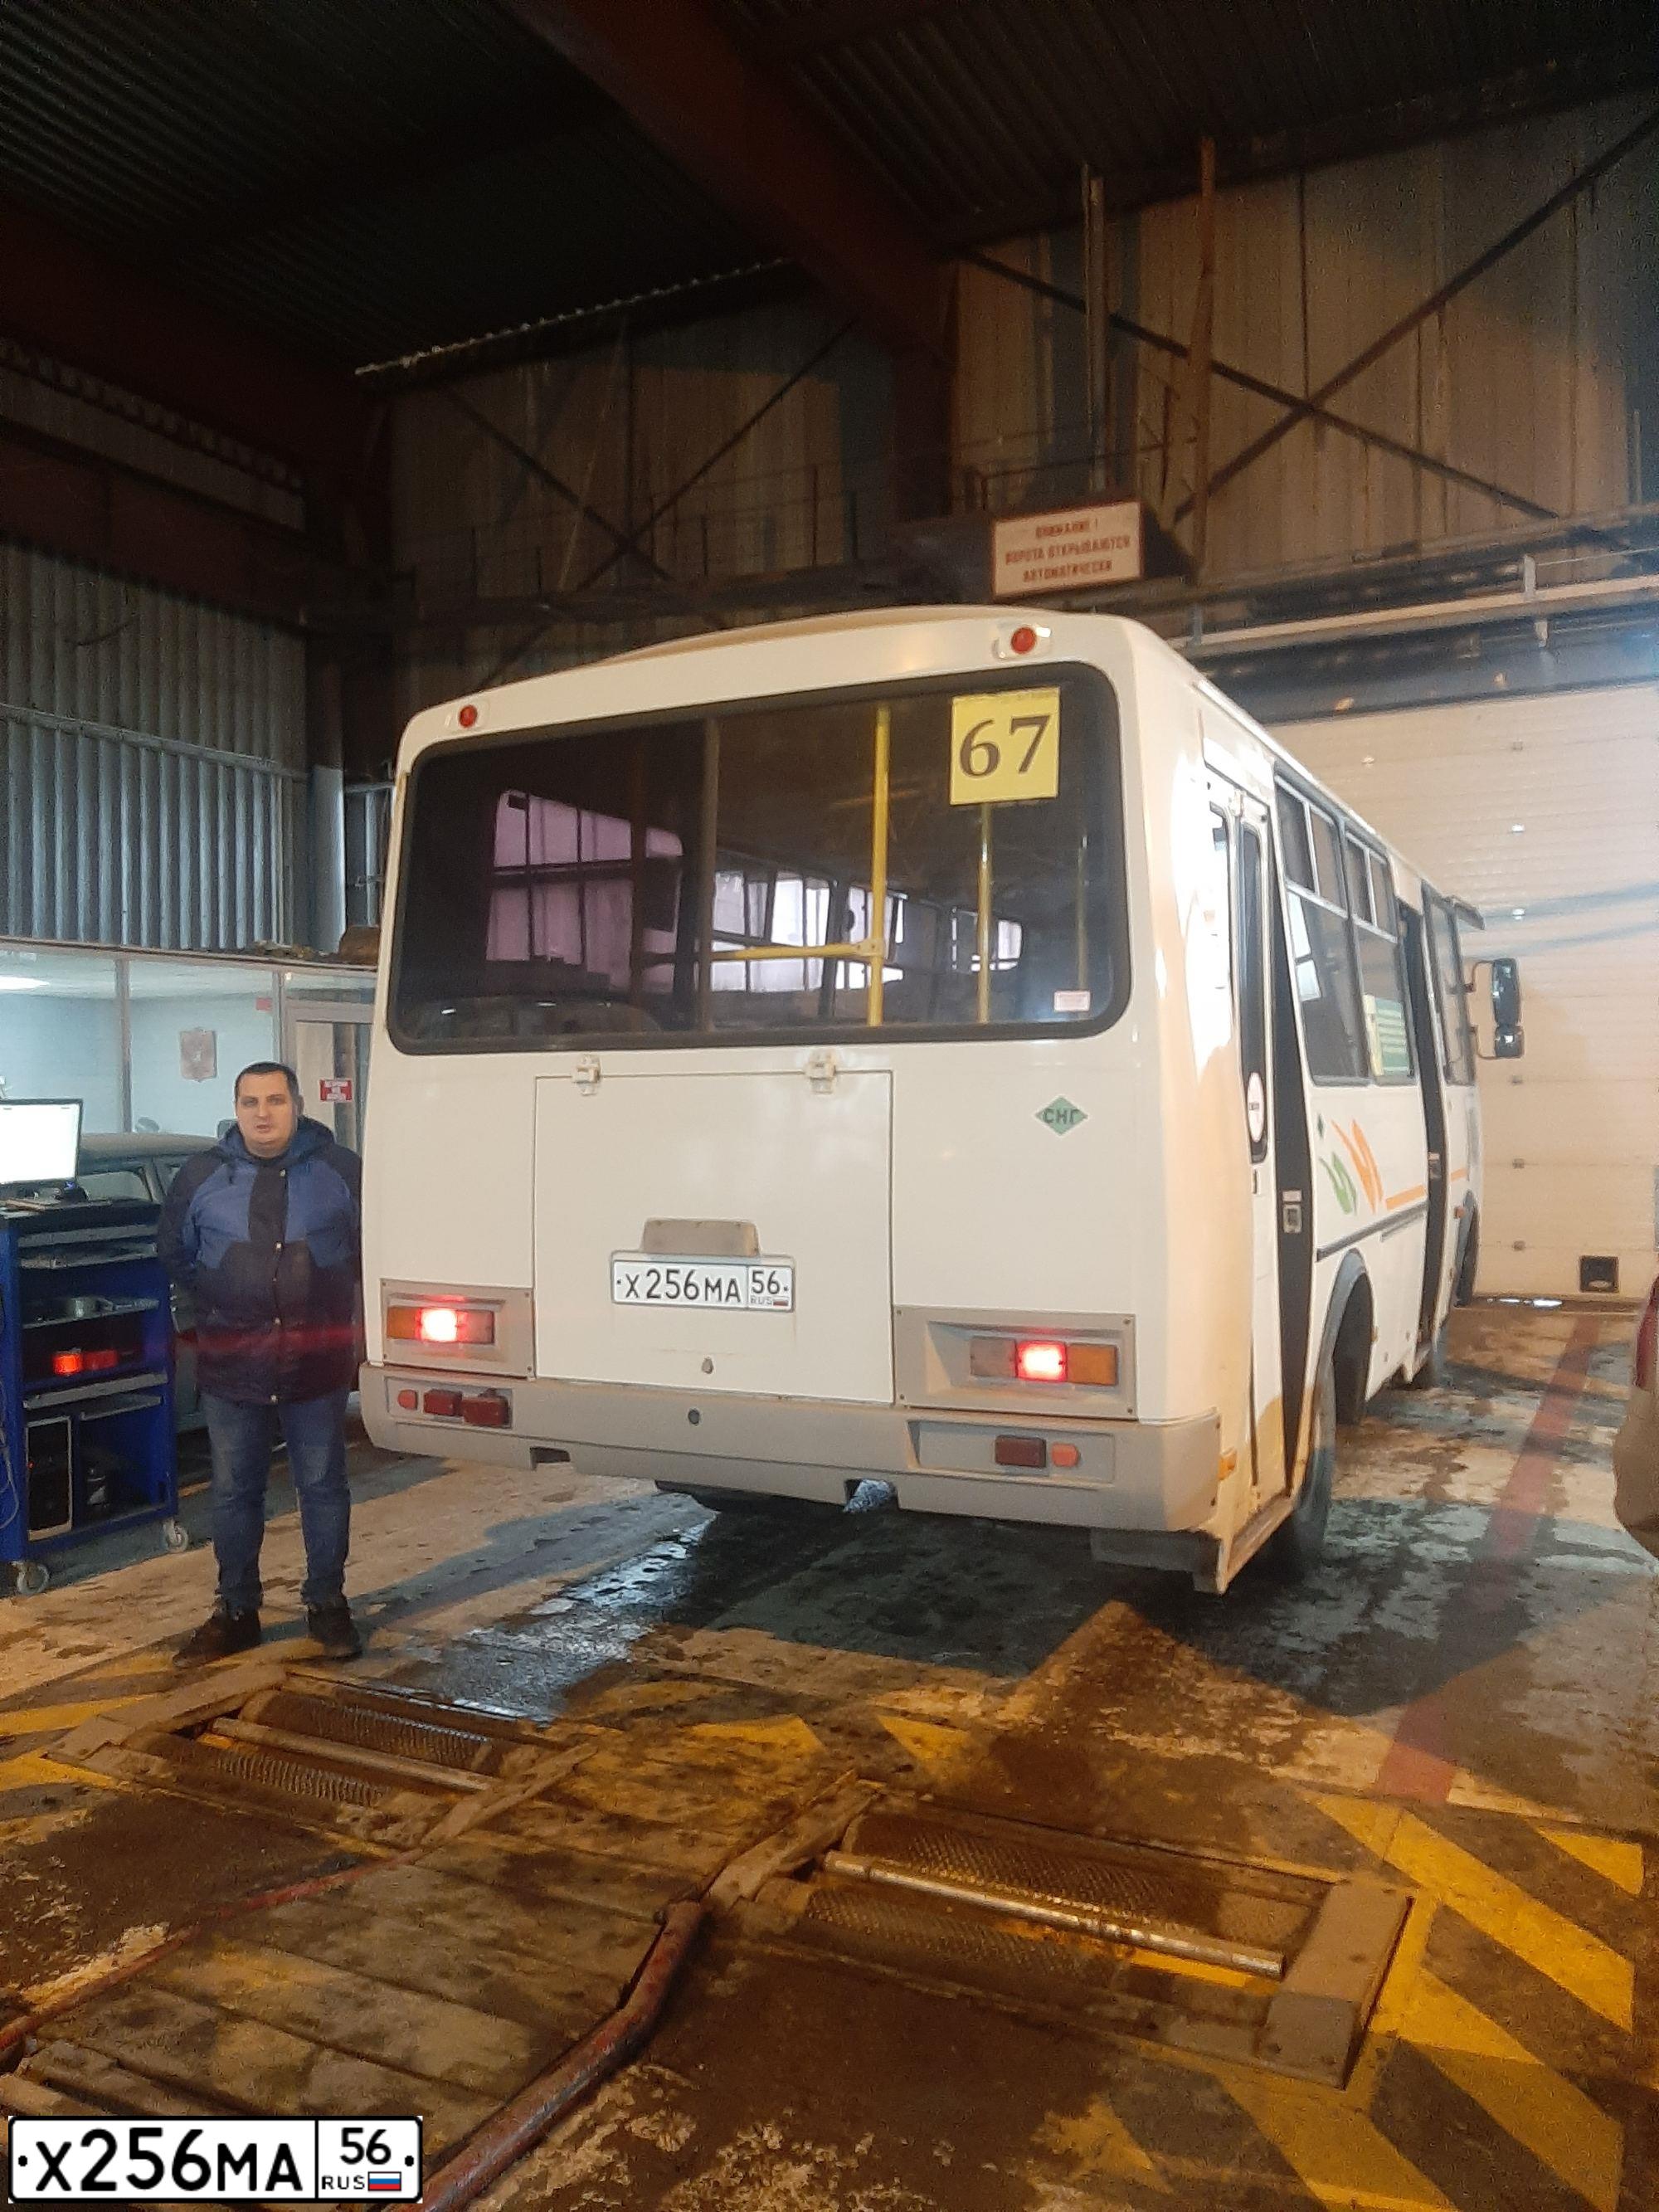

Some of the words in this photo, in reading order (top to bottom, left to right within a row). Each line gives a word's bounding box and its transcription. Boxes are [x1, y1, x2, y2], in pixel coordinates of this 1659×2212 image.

[1005, 546, 1044, 565] ВОРОТА
[1047, 535, 1131, 559] ОТКРЫВАЮТСЯ
[1023, 560, 1112, 582] АВТОМАТИЧЕСКИ
[960, 714, 1051, 777] 67
[1042, 1108, 1080, 1124] СНГ
[751, 1270, 781, 1294] 56
[750, 1296, 773, 1305] RUS
